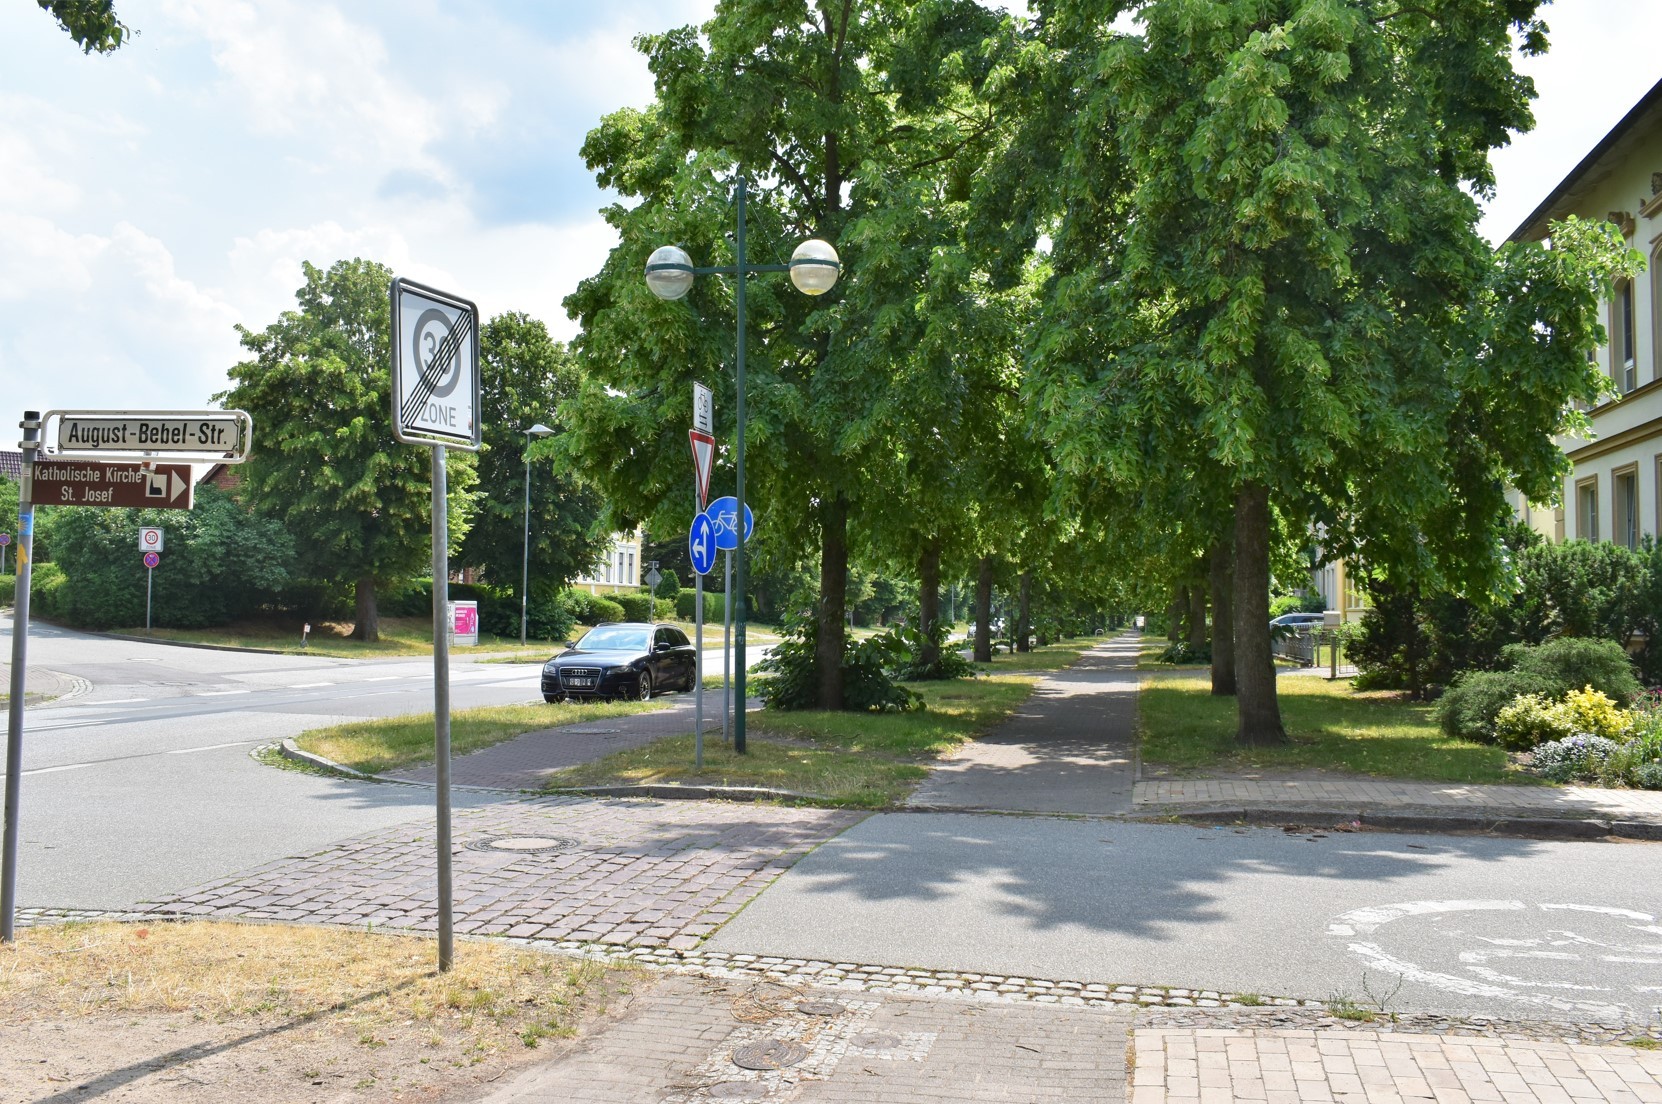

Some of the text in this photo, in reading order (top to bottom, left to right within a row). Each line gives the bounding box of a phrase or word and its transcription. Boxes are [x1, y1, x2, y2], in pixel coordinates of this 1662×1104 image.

[423, 331, 452, 375] 30
[421, 403, 456, 428] ZONE
[68, 422, 227, 449] August-Bebel-Str.
[34, 464, 143, 484] Katholische Kirche
[61, 486, 114, 503] St. Josef
